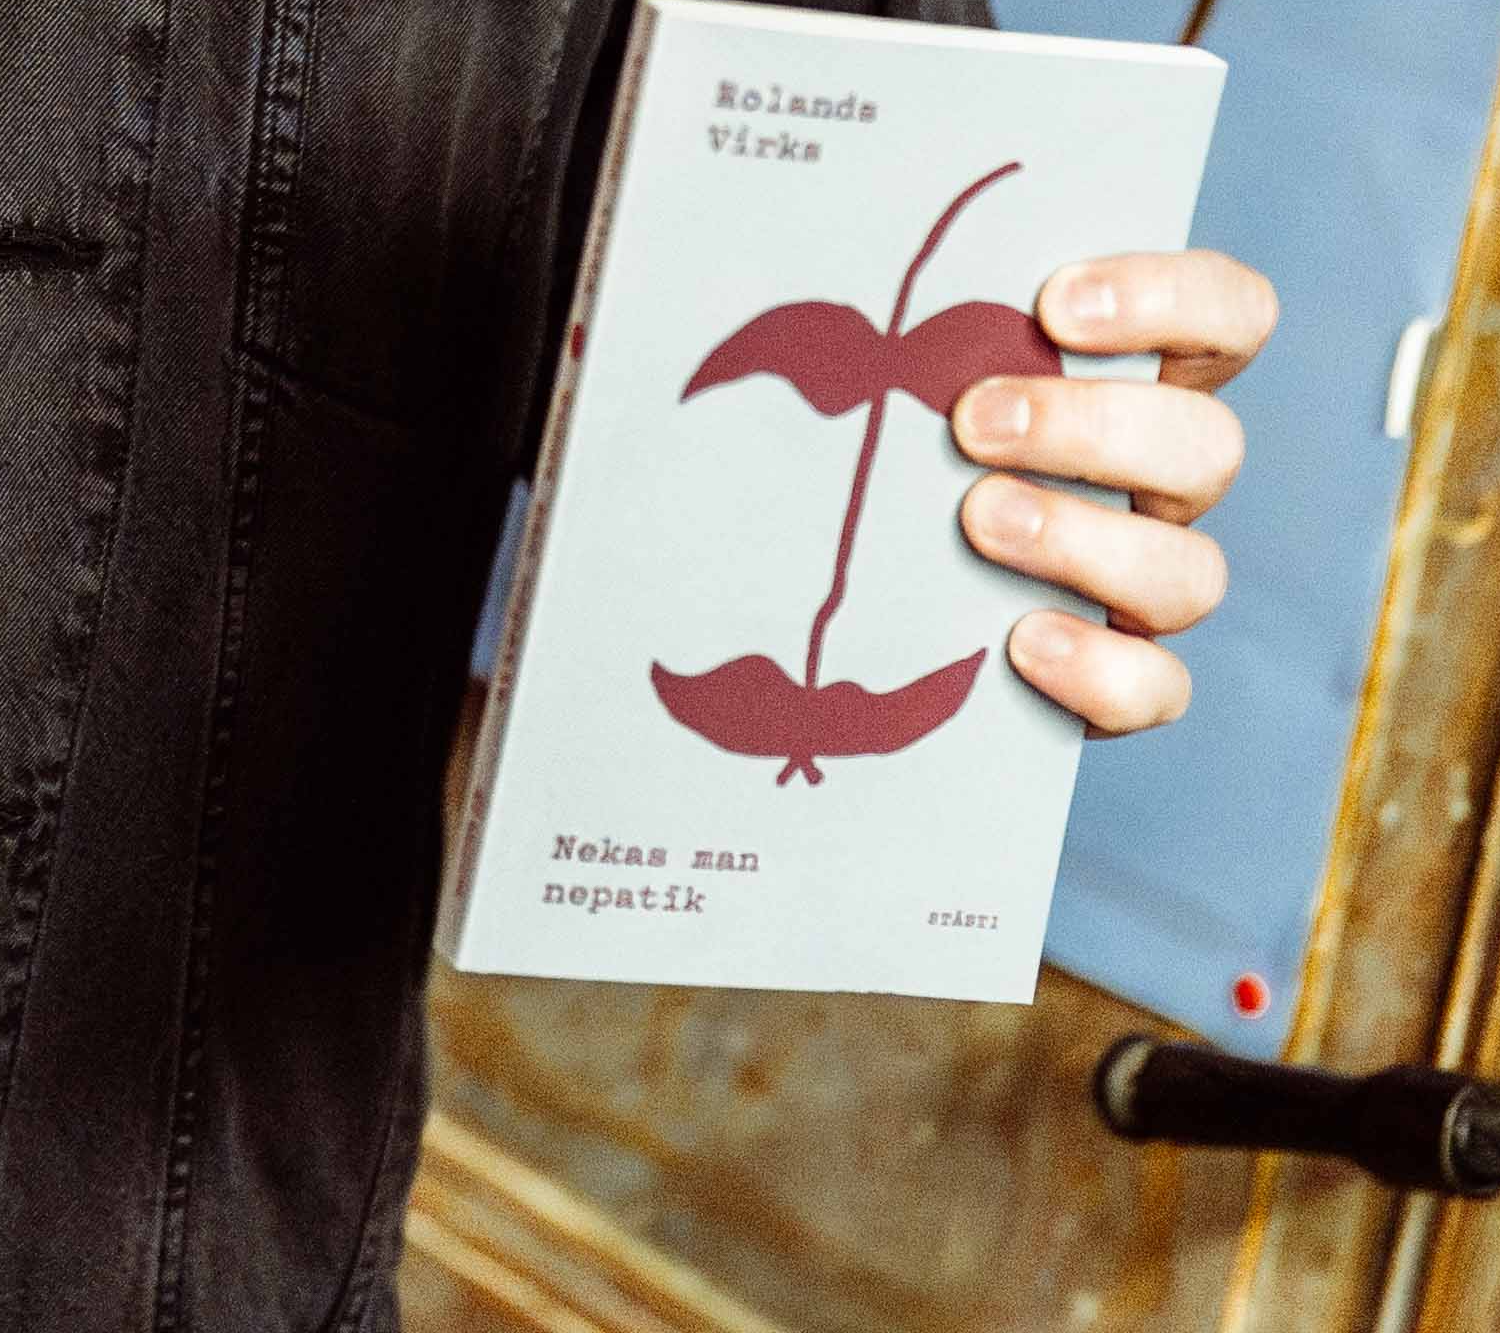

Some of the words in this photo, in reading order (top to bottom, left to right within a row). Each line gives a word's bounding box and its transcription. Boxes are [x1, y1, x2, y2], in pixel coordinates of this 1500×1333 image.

[713, 80, 878, 123] Rolands
[551, 834, 668, 869] Nekas
[691, 847, 761, 873] man
